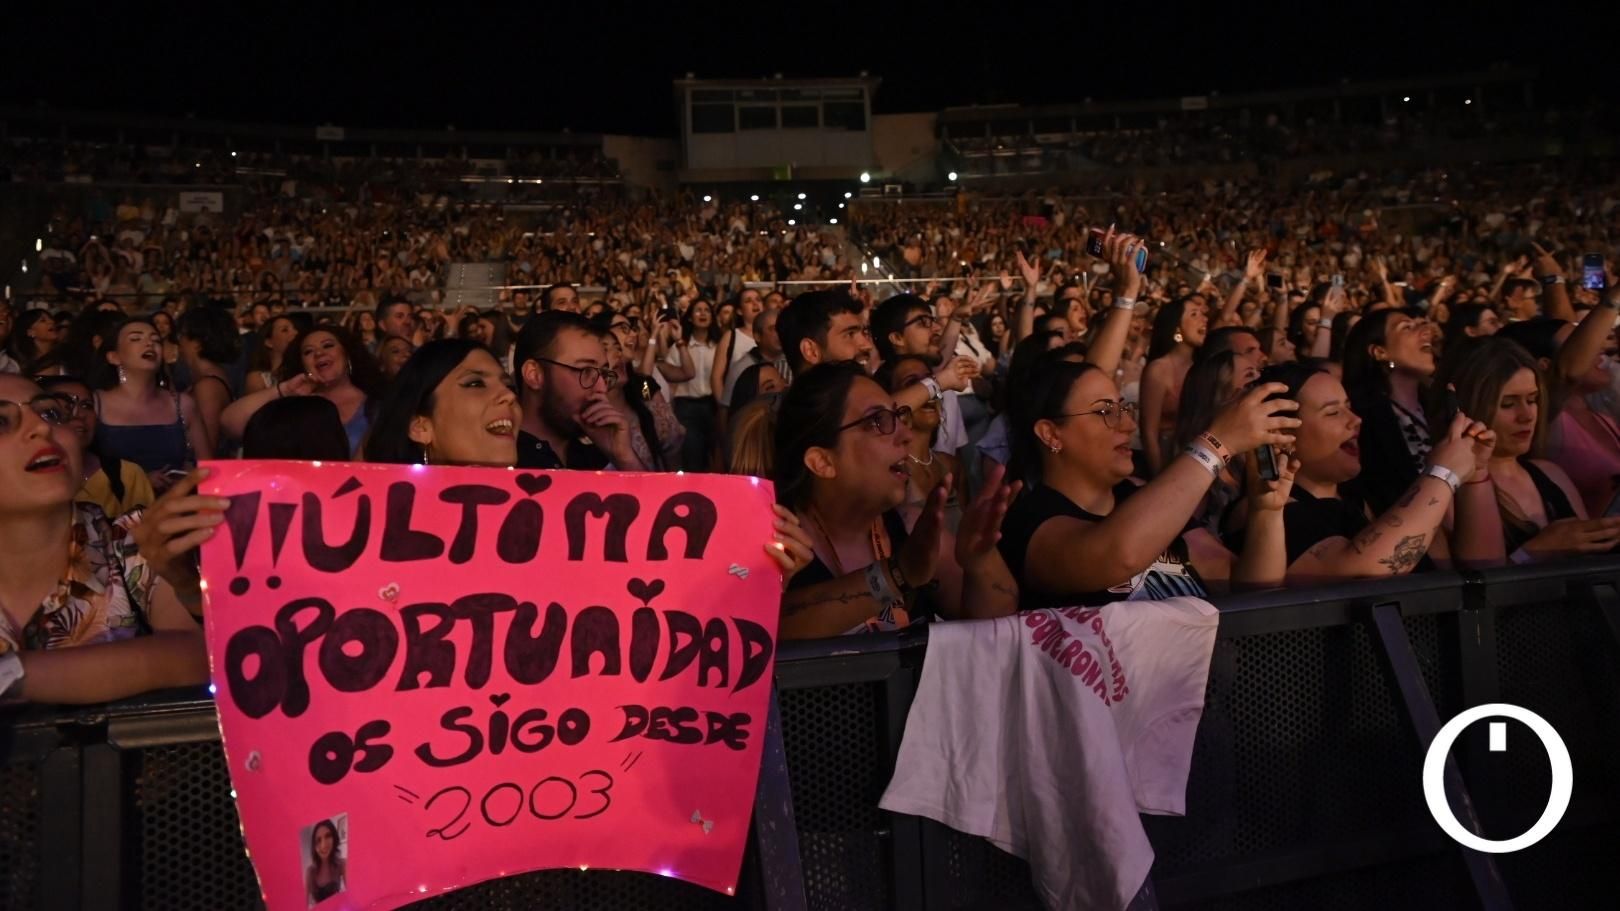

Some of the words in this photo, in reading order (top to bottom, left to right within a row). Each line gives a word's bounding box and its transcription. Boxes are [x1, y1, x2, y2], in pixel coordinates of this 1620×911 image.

[225, 578, 773, 719] OPORTUNIDAD
[308, 719, 394, 784] OS
[414, 692, 590, 767] SIGO
[607, 704, 751, 750] DESDE
